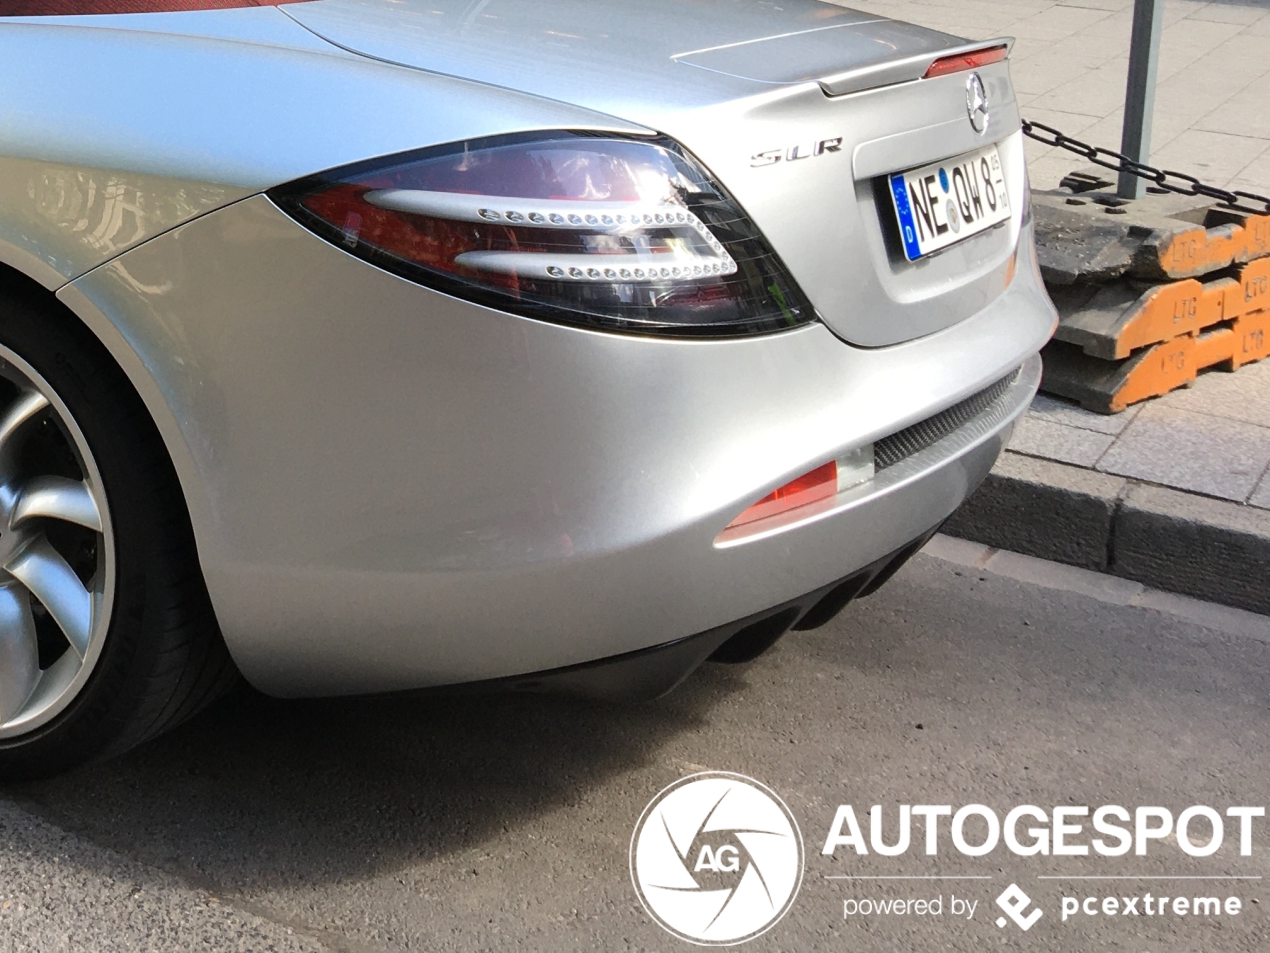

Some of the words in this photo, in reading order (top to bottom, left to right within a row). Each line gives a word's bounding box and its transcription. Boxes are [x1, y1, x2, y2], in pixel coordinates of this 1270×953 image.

[750, 136, 843, 168] SLR
[908, 174, 949, 243] NE
[952, 160, 985, 225] QW
[980, 156, 997, 213] 8
[1172, 296, 1197, 324] LTG
